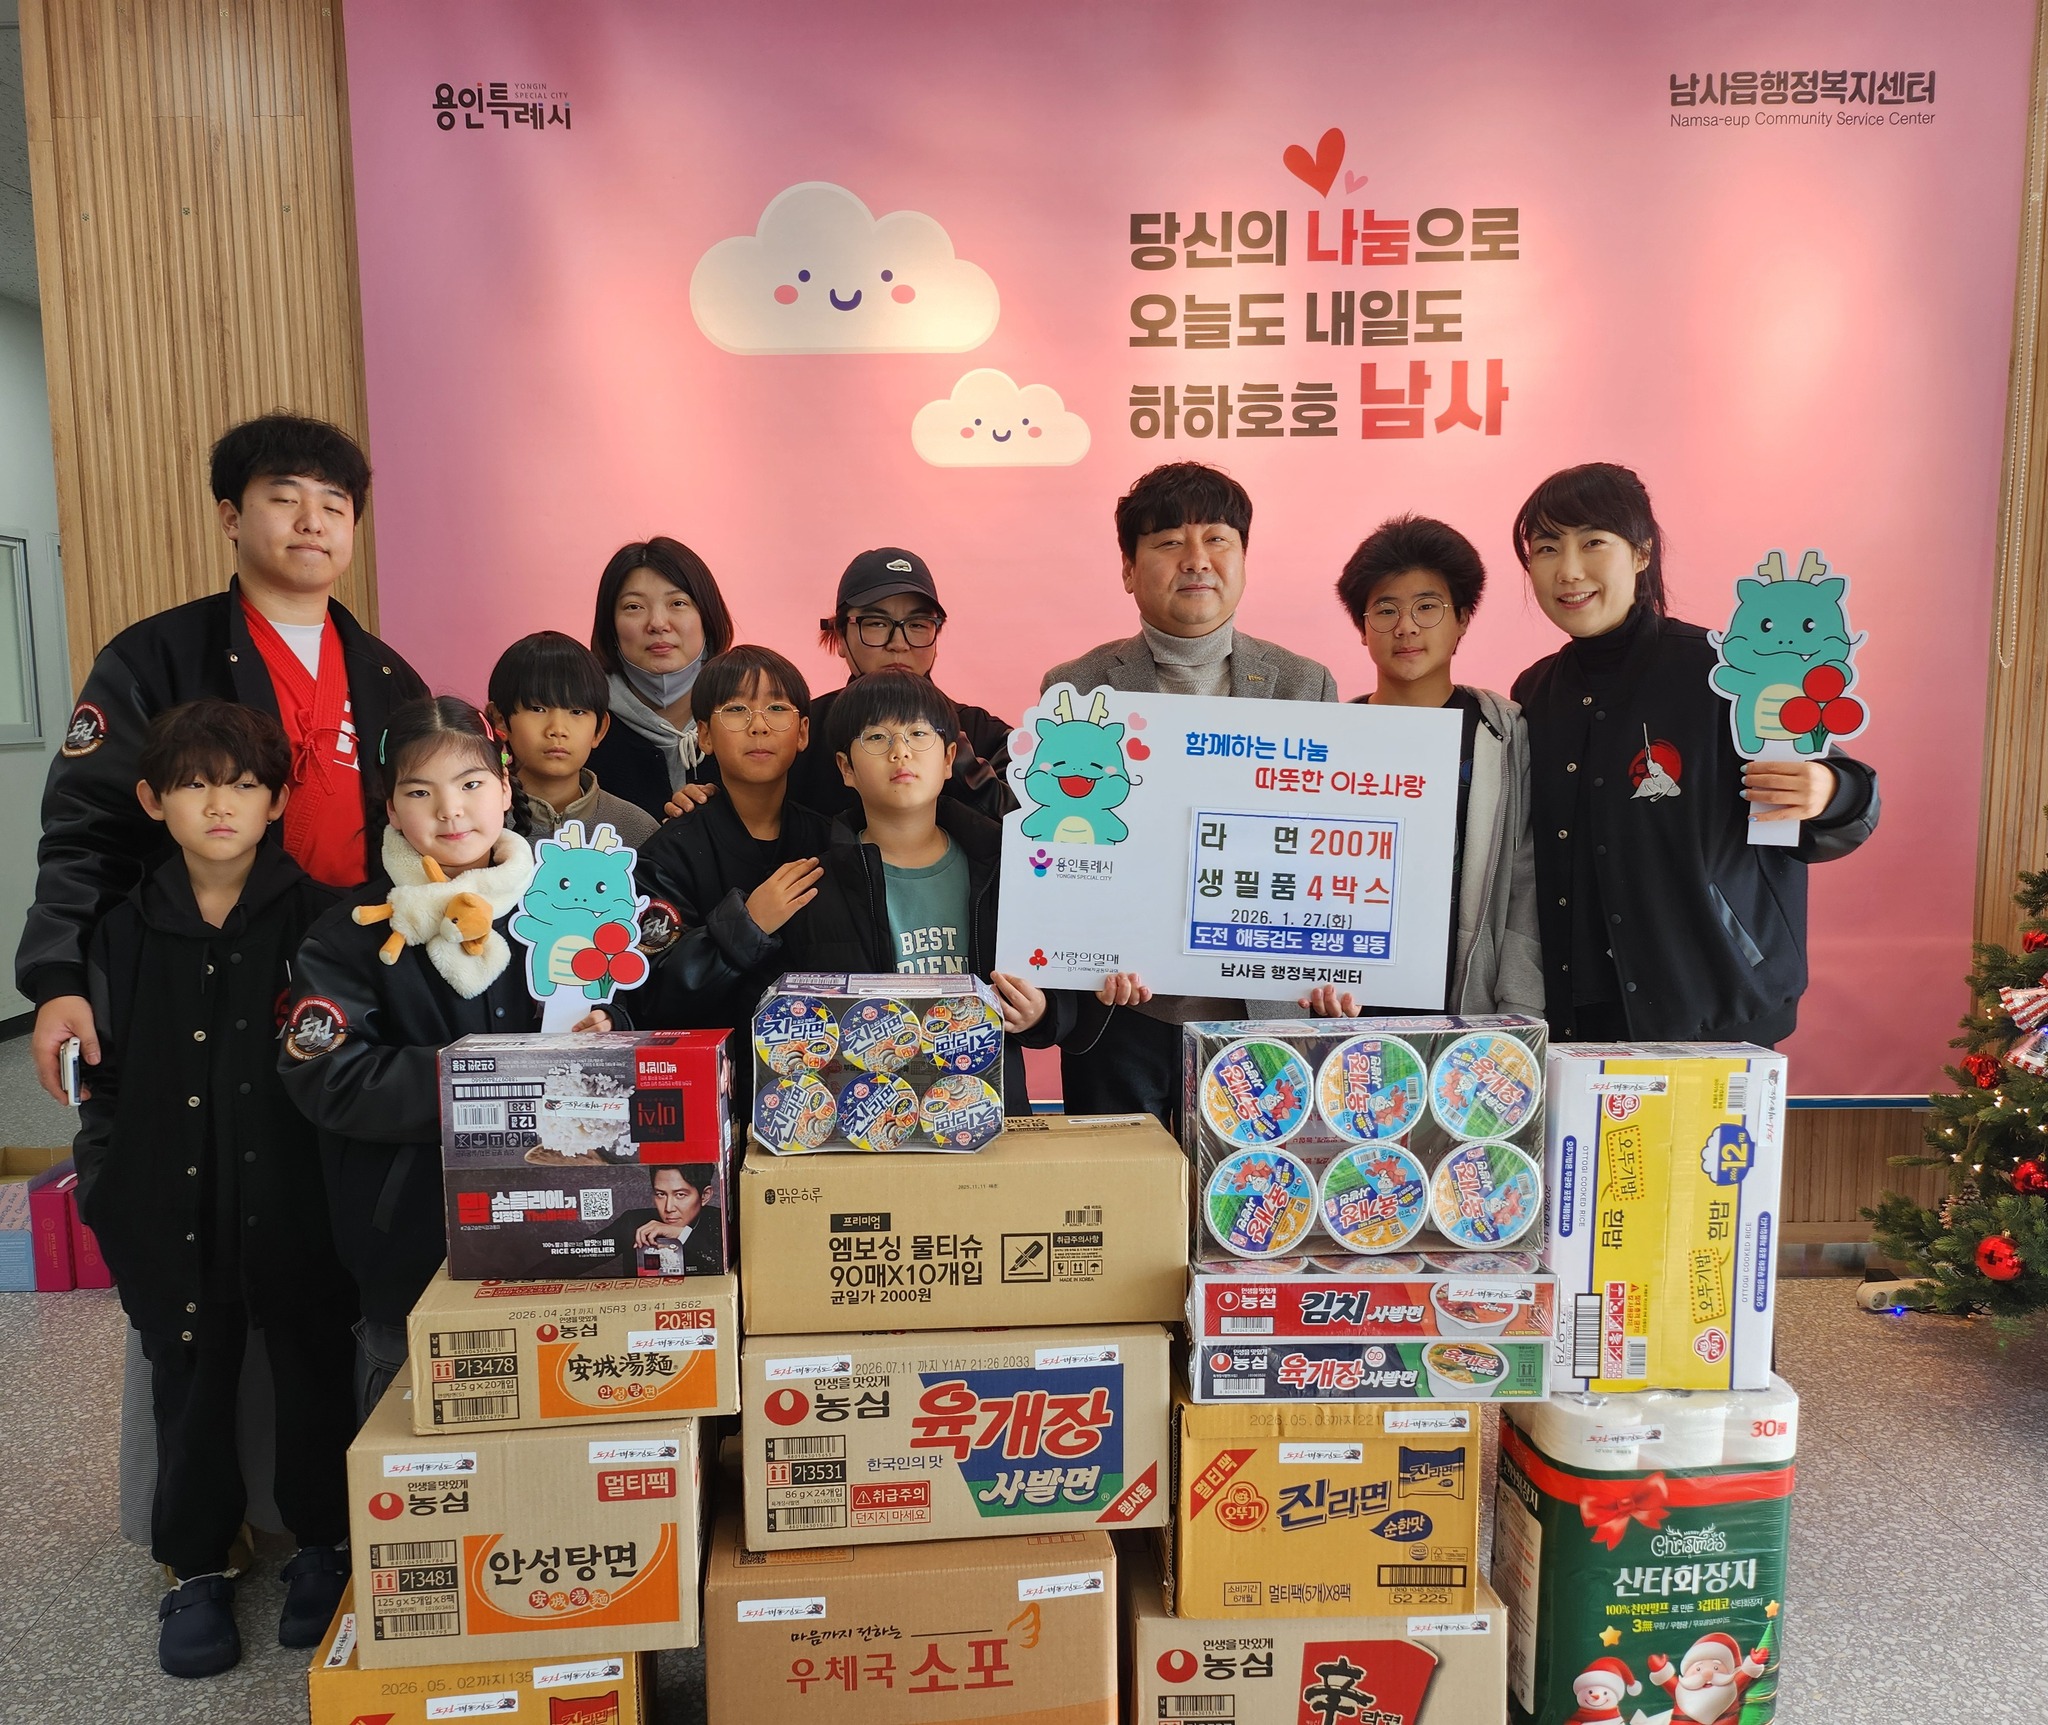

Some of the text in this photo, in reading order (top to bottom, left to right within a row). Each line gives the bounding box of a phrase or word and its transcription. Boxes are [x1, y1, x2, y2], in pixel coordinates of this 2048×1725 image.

[1670, 70, 1936, 106] 남사읍행정복지센터
[432, 82, 572, 131] 용인특례시
[1670, 111, 1935, 128] Namsa-eup Community Service Center
[1129, 207, 1520, 271] 당신의 나눔으로
[1129, 290, 1462, 349] 오늘도 내일도
[1129, 359, 1509, 440] 하하호호 남사
[1185, 731, 1329, 762] 함께하는 나눔
[1255, 767, 1426, 798] 따뜻한 이웃사랑
[1309, 828, 1393, 860] 200개
[1056, 857, 1113, 874] 용인특례시
[900, 927, 957, 956] BEST
[1194, 926, 1386, 955] 도전 해동검도 원생 일동
[1051, 951, 1119, 966] 사랑의열매
[1220, 962, 1362, 985] 남사읍 행정복지센터
[761, 1017, 826, 1046] 진라면
[845, 1014, 905, 1057] 진라면
[935, 1022, 996, 1054] 진라면
[452, 1059, 495, 1071] 오프라인 전용
[645, 1061, 677, 1074] 백미밥
[512, 1102, 532, 1112] R28
[769, 1084, 809, 1144] 진라면
[845, 1083, 899, 1138] 진라면
[934, 1099, 997, 1133] 진라면
[1618, 1136, 1638, 1198] 오뚜기밥
[1721, 1144, 1748, 1171] 12
[777, 1187, 823, 1205] 맑은하루
[1562, 1140, 1574, 1233] 오뚜기밥은 무균화 포장 제품입니다.
[1578, 1146, 1589, 1227] OTTOGI COOKED RICE
[842, 1215, 881, 1230] 프리미엄
[1602, 1209, 1624, 1250] 흰밥
[1708, 1200, 1730, 1240] 흰밥
[1744, 1222, 1752, 1239] RICE
[551, 1247, 615, 1255] RICE SOMMELIER
[829, 1234, 983, 1262] 엠보싱 물티슈
[1056, 1235, 1100, 1245] 취급주의사항
[830, 1261, 983, 1288] 90매X10개입
[1695, 1253, 1714, 1312] 오뚜기밥
[830, 1287, 931, 1305] 균일가 2000원
[1742, 1275, 1750, 1303] OTTOGI
[1756, 1279, 1765, 1307] 오뚜기밥은
[599, 1300, 702, 1314] N5A3 3662
[1241, 1294, 1276, 1309] 농심
[1299, 1290, 1371, 1326] 김치
[578, 1315, 598, 1323] 맛있게
[699, 1314, 712, 1328] S
[1366, 1305, 1425, 1324] 사발면
[559, 1323, 598, 1339] 농심
[1709, 1334, 1722, 1356] 오뚜기
[458, 1357, 515, 1377] 가3478
[568, 1352, 676, 1382] 安城湯麵
[855, 1356, 1030, 1376] 2026.07.11 까지 Y1A7 21:26 2033
[1233, 1355, 1268, 1371] 농심
[1278, 1352, 1364, 1390] 육개장
[449, 1383, 467, 1391] 125
[814, 1375, 890, 1391] 인생을 맛있게
[1361, 1370, 1418, 1388] 사발면
[598, 1383, 657, 1401] 안성탕면
[814, 1390, 890, 1423] 농심
[909, 1379, 1114, 1460] 육개장
[794, 1464, 843, 1482] 가3531
[866, 1454, 943, 1472] 한국인의 맛
[1409, 1462, 1454, 1483] 진라면
[408, 1479, 468, 1490] 인생을 맛있게
[604, 1471, 669, 1497] 멀티팩
[977, 1466, 1101, 1507] 사발면
[1193, 1454, 1238, 1501] 멀티팩
[408, 1491, 469, 1516] 농심
[785, 1490, 798, 1499] 86
[872, 1487, 925, 1503] 취급주의
[1117, 1482, 1152, 1517] 행사용
[1276, 1478, 1392, 1532] 진라면
[855, 1509, 926, 1525] 던지지 마세요
[1225, 1504, 1259, 1520] 오뚜기
[1383, 1515, 1425, 1539] 순한맛
[1651, 1532, 1727, 1557] Christmas
[489, 1541, 638, 1585] 안성탕면
[401, 1570, 454, 1589] 가3481
[1227, 1584, 1258, 1594] 소비기간
[1612, 1558, 1757, 1597] 산타화장지
[378, 1598, 394, 1607] 125
[1233, 1594, 1253, 1603] 6개월
[1268, 1583, 1351, 1604] 멀티팩(5개)X8팩
[1393, 1594, 1448, 1604] 52 225
[1605, 1597, 1763, 1616] 100% 천연펄프 만든 3겹데코 산타화장지
[790, 1624, 902, 1646] 마음까지 전하는
[1202, 1638, 1273, 1651] 인생을 맛있게
[786, 1638, 1014, 1695] 우체국 소포
[1202, 1652, 1273, 1680] 농심
[1303, 1655, 1376, 1725] 辛
